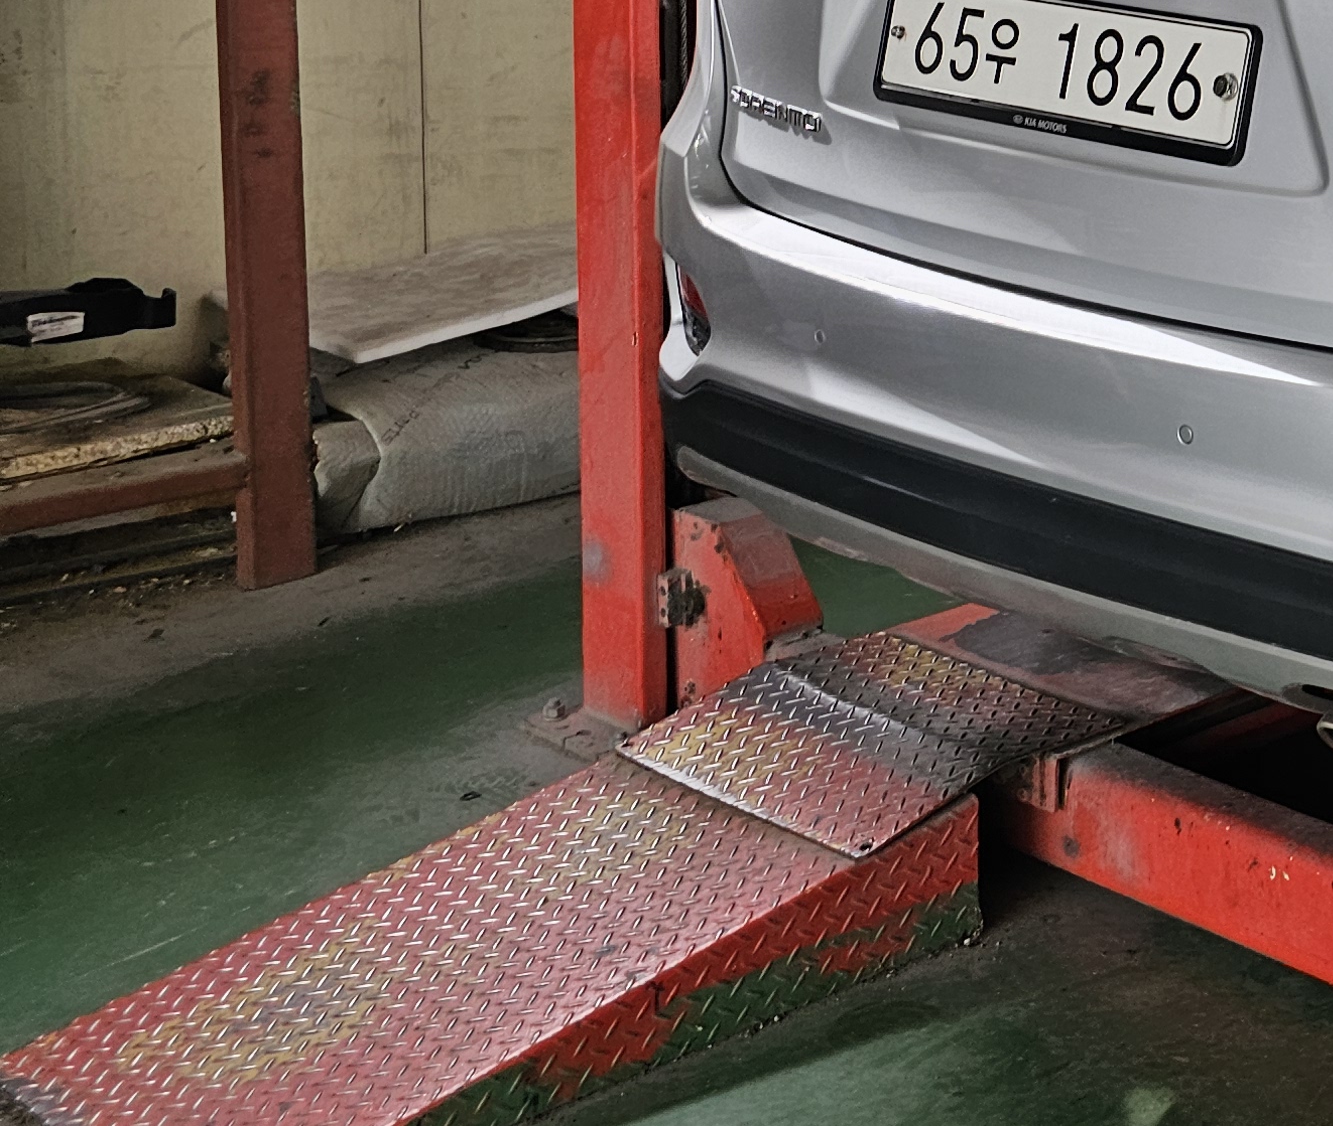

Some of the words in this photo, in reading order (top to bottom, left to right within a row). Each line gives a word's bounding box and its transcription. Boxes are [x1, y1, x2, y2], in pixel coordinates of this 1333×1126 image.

[914, 2, 1021, 85] 65우
[1057, 23, 1203, 121] 1826
[1024, 116, 1037, 127] KIA
[1037, 119, 1068, 134] MOTORS
